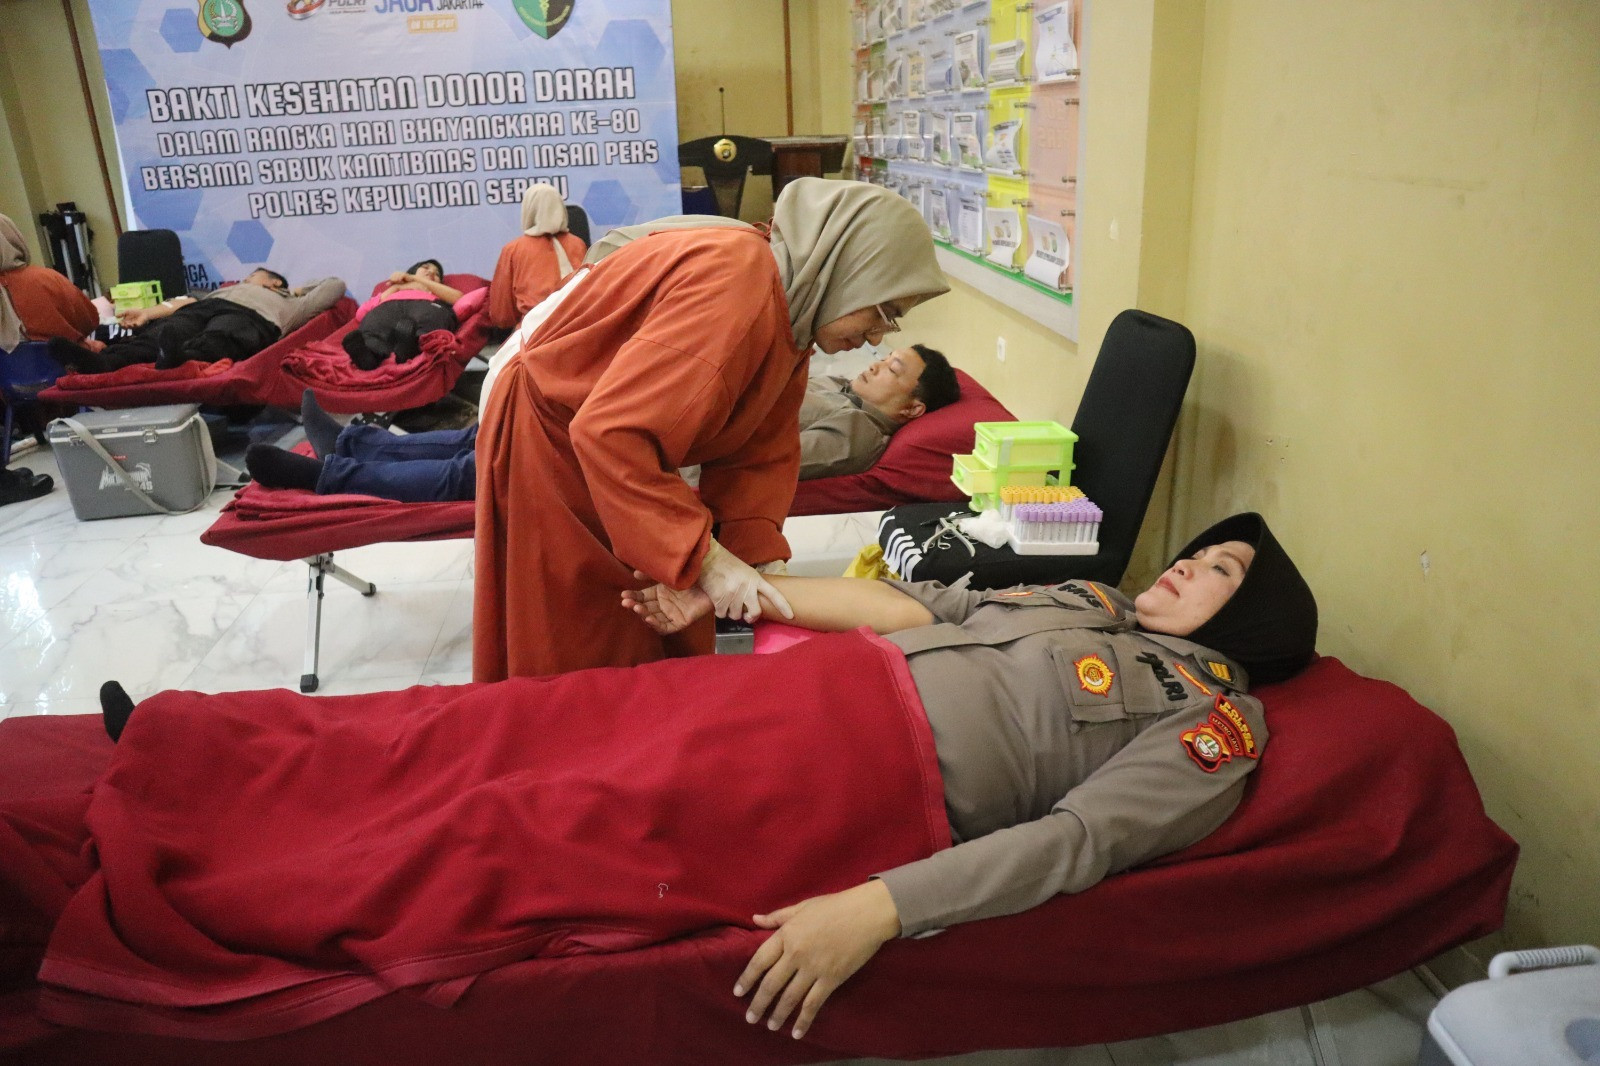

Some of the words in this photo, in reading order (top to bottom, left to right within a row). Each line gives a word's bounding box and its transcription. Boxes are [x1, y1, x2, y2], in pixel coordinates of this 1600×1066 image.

[146, 85, 240, 123] BAKTI
[245, 75, 419, 118] KESEHATAN
[423, 71, 527, 108] DONOR
[533, 67, 636, 102] DARAH
[157, 129, 242, 158] DALAM
[245, 123, 338, 153] RANGKA
[341, 120, 397, 147] HARI
[400, 111, 566, 144] BHAYANGKARA
[569, 108, 641, 136] KE-80
[141, 161, 253, 192] BERSAMA
[257, 155, 335, 185] SABUK
[338, 147, 478, 180] KAMTIBMAS
[481, 145, 528, 172] DAN
[533, 142, 600, 169] INSAN
[604, 139, 659, 166] PERS
[248, 188, 339, 220] POLRES
[342, 179, 481, 214] KEPULAUAN
[485, 174, 570, 205] SERU
[1212, 717, 1232, 736] METRO
[1231, 738, 1241, 753] JAYA
